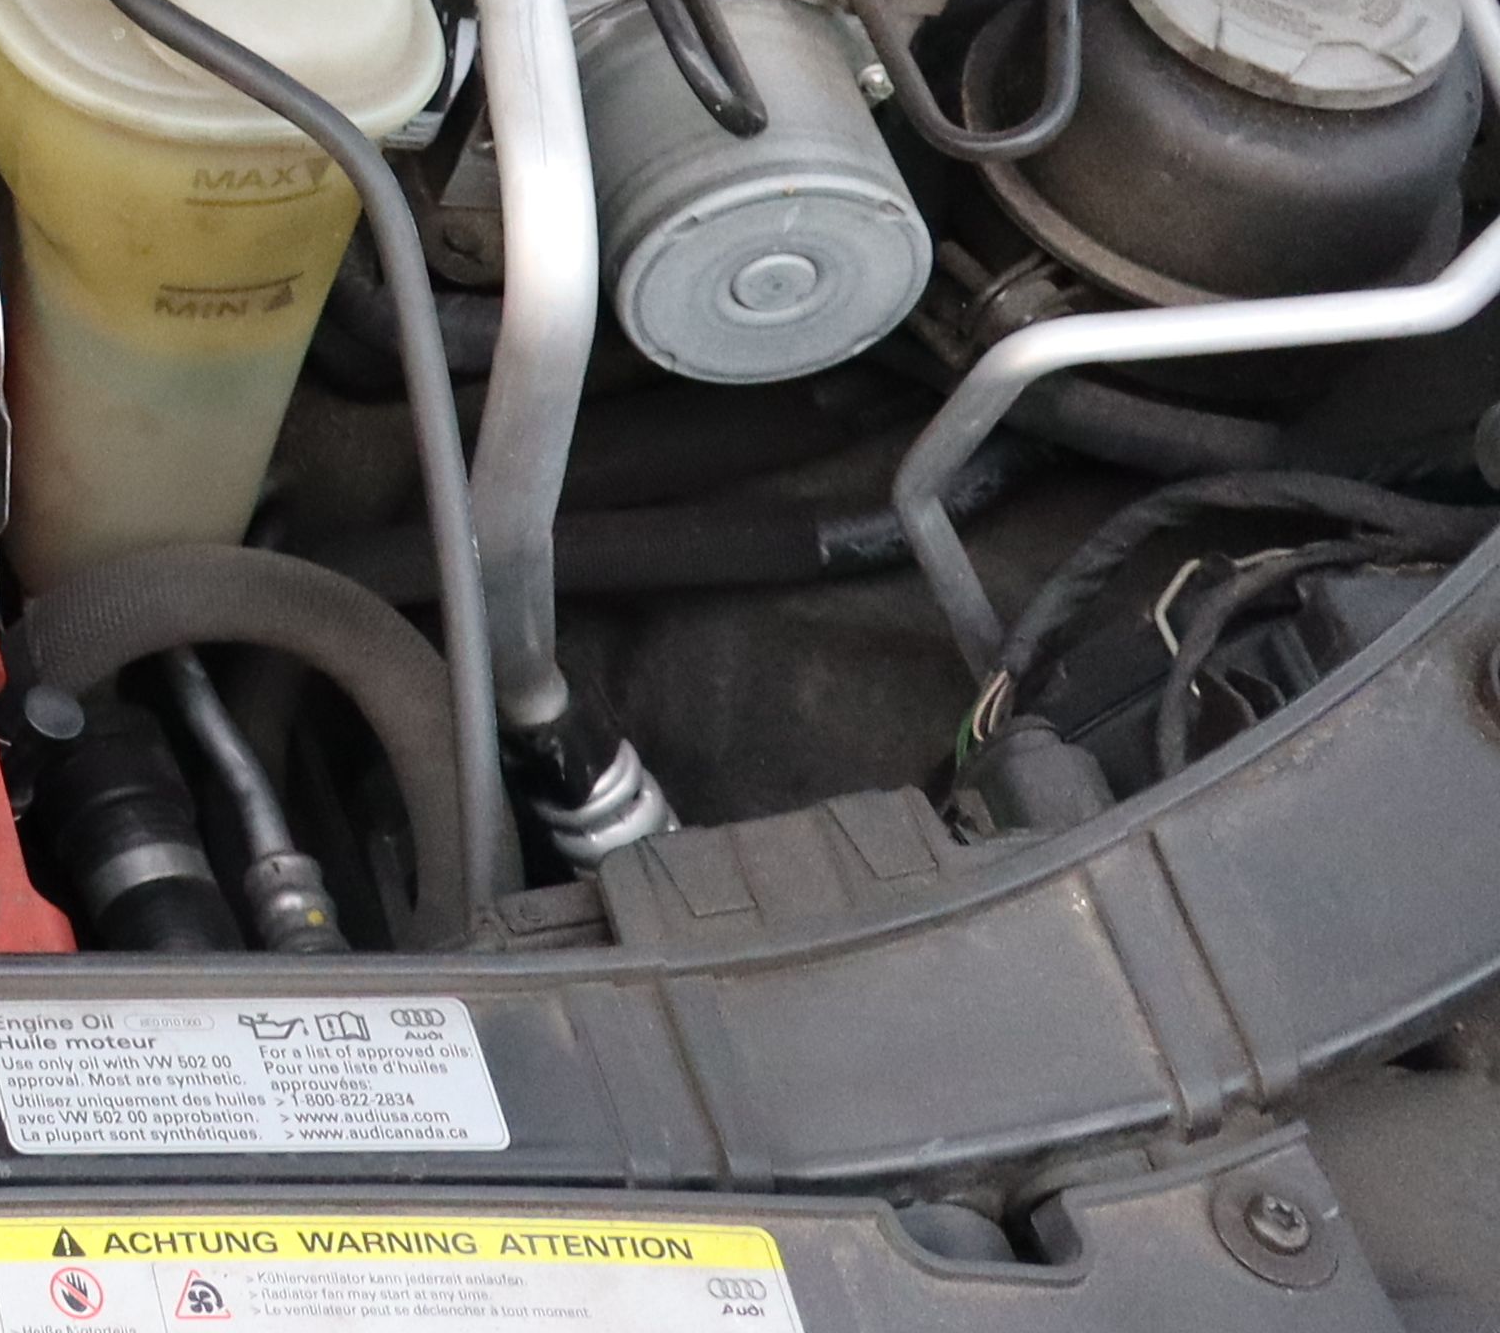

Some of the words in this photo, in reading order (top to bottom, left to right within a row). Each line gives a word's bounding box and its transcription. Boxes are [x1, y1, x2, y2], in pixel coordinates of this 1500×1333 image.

[192, 165, 301, 191] MAX
[153, 295, 250, 321] MIN
[81, 1014, 115, 1030] Oil
[66, 1035, 157, 1050] moteur
[404, 1029, 444, 1041] Audi
[259, 1046, 286, 1060] For
[293, 1048, 301, 1059] a
[305, 1046, 332, 1059] list
[336, 1045, 353, 1059] of
[357, 1045, 435, 1062] approved
[440, 1045, 474, 1059] oils:
[0, 1056, 34, 1071] Use
[39, 1056, 74, 1073] only
[80, 1057, 100, 1071] oil
[104, 1057, 140, 1070] with
[143, 1056, 172, 1069] VW
[177, 1056, 207, 1069] 502
[211, 1055, 232, 1069] 00
[264, 1062, 303, 1076] Pour
[308, 1063, 340, 1075] une
[343, 1061, 378, 1075] liste
[382, 1060, 449, 1075] d'huiles
[8, 1073, 83, 1090] approval.
[89, 1073, 131, 1087] Most
[136, 1076, 162, 1087] are
[166, 1072, 246, 1089] synthetic.
[270, 1078, 373, 1094] approuvées:
[11, 1094, 71, 1109] Utilisez
[77, 1094, 178, 1111] uniquement
[182, 1093, 211, 1107] des
[216, 1092, 267, 1107] huiles
[291, 1093, 416, 1107] 1-800-822-2834
[17, 1114, 55, 1126] avec
[59, 1111, 88, 1125] VW
[94, 1111, 122, 1125] 502
[127, 1111, 148, 1125] 00
[153, 1110, 260, 1128] approbation.
[295, 1110, 450, 1124] www.audiusa.com
[20, 1129, 41, 1142] La
[45, 1128, 106, 1145] plupart
[110, 1130, 146, 1142] sont
[150, 1127, 263, 1145] synthétiques.
[300, 1126, 469, 1141] www.audicanada.ca
[103, 1230, 279, 1255] ACHTUNG
[296, 1231, 478, 1255] WARNING
[500, 1233, 694, 1260] ATTENTION
[256, 1271, 365, 1285] Kühlerventilator
[368, 1272, 402, 1285] kann
[405, 1272, 463, 1287] jederzeit
[261, 1288, 318, 1301] Radiator
[322, 1288, 345, 1301] fan
[348, 1290, 378, 1303] may
[380, 1289, 411, 1301] start
[414, 1290, 427, 1301] at
[431, 1291, 456, 1304] any
[458, 1289, 493, 1302] time.
[264, 1303, 282, 1316] Le
[284, 1303, 358, 1317] ventilateur
[361, 1304, 393, 1318] peut
[394, 1306, 411, 1317] se
[413, 1303, 486, 1318] déclencher
[490, 1304, 499, 1317] à
[501, 1305, 529, 1319] tout
[721, 1304, 765, 1317] Audi
